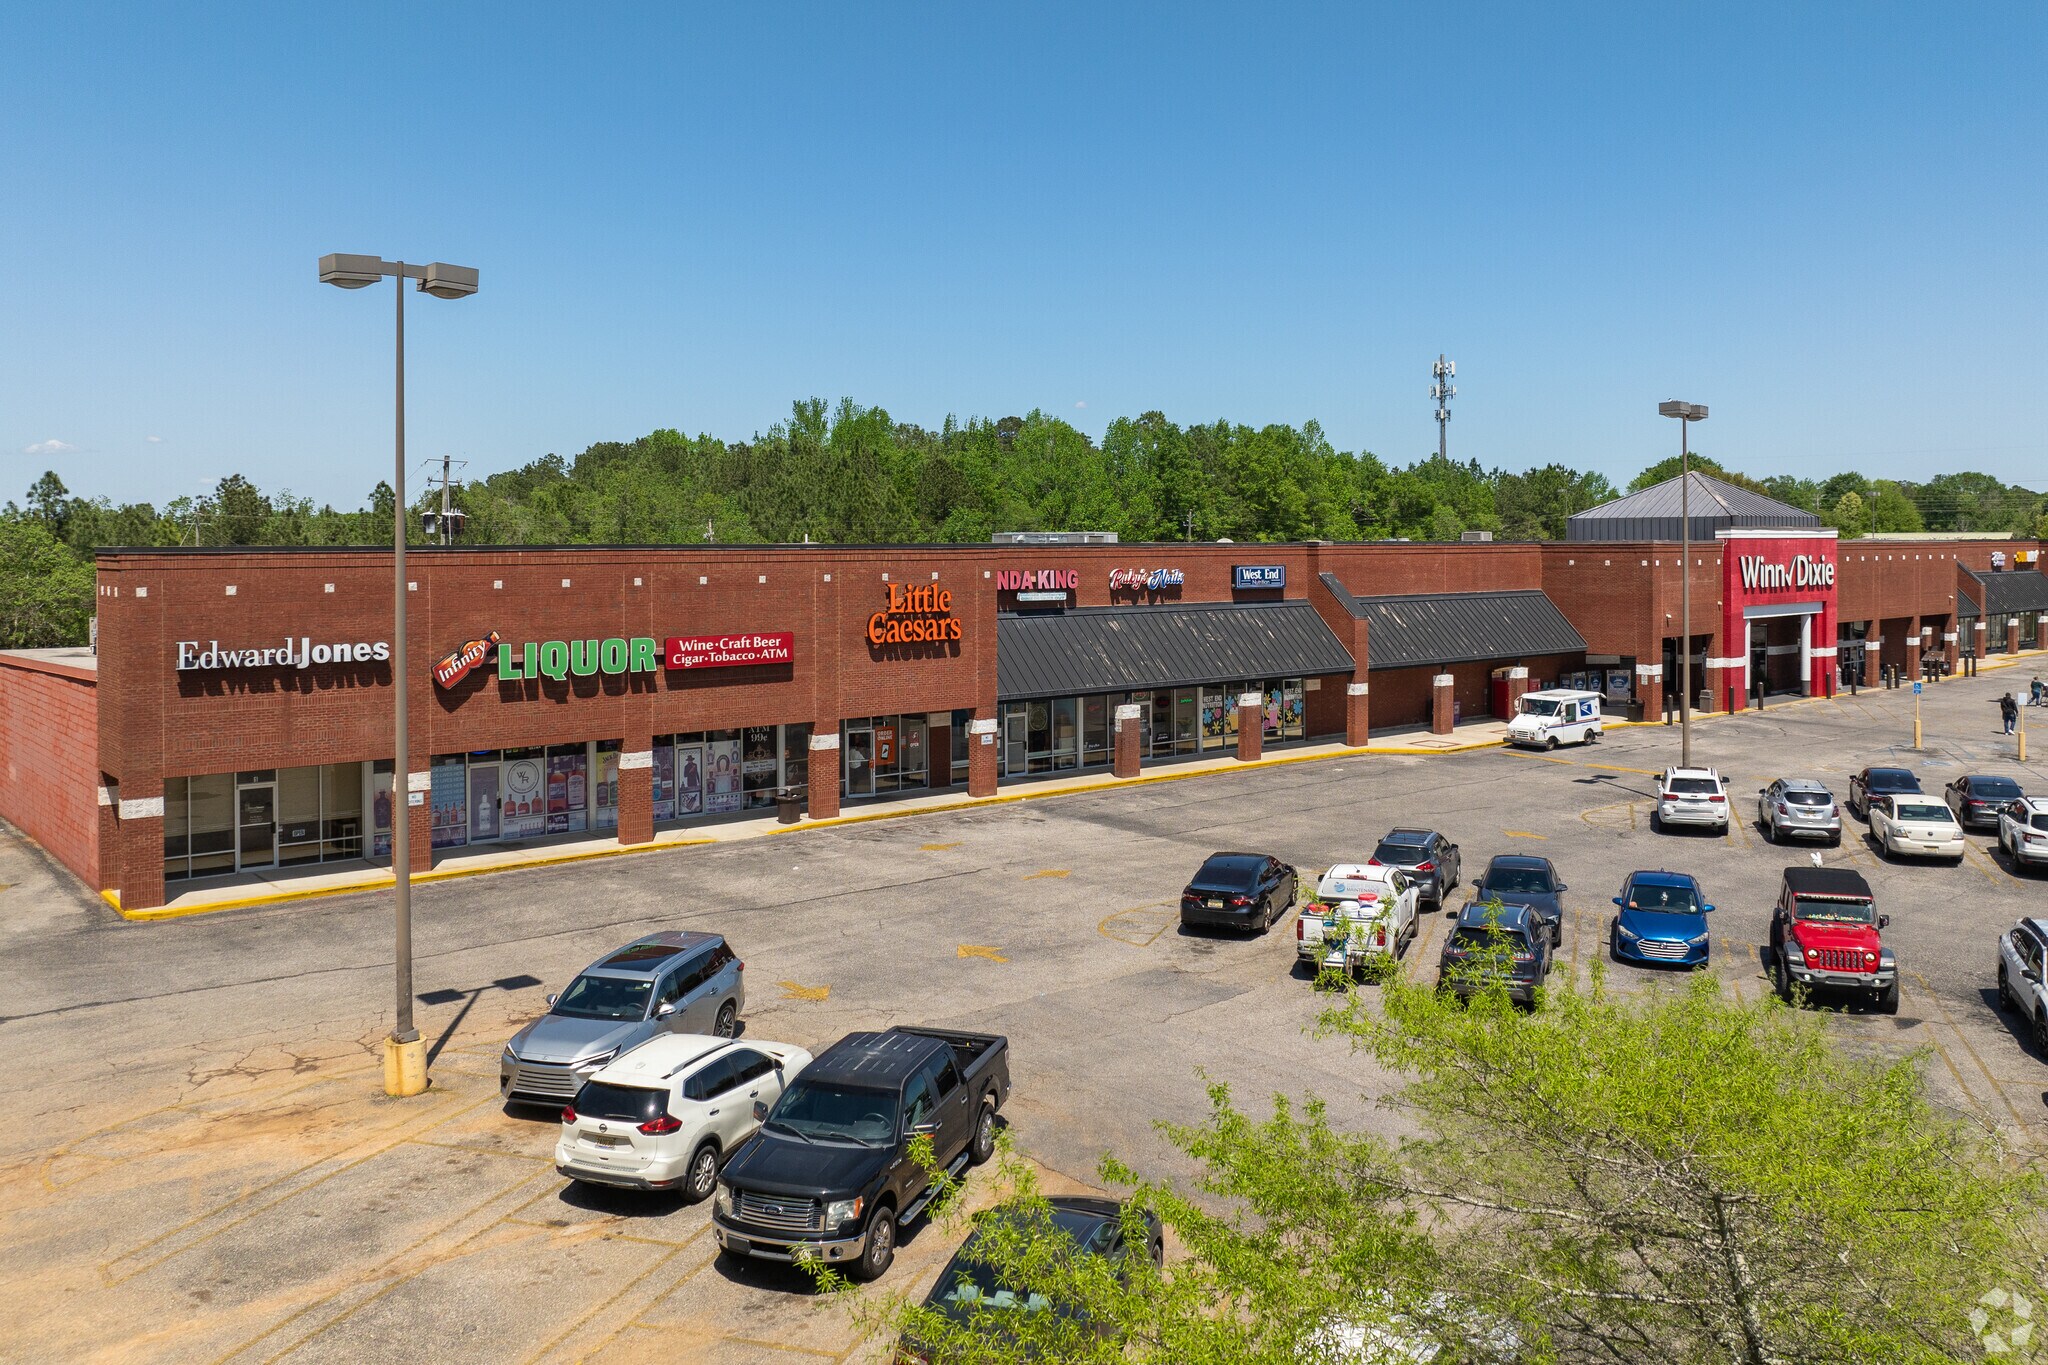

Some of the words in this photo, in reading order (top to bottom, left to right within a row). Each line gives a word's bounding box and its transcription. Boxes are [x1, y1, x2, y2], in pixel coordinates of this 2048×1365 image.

[1038, 569, 1078, 589] KING
[1109, 568, 1148, 590] Ruby's
[1147, 568, 1185, 590] Nails
[1242, 568, 1262, 580] West
[1264, 568, 1279, 580] End
[888, 582, 952, 613] Little
[868, 612, 962, 644] Caesars
[176, 637, 293, 670] Edward
[296, 637, 390, 669] Jones
[679, 640, 714, 651] Wine
[720, 636, 751, 650] Craft
[753, 636, 781, 648] Beer
[438, 640, 487, 683] Infinity
[498, 637, 658, 681] LIQUOR
[672, 653, 703, 667] Cigar
[708, 650, 755, 662] Tobacco
[761, 648, 788, 659] ATM
